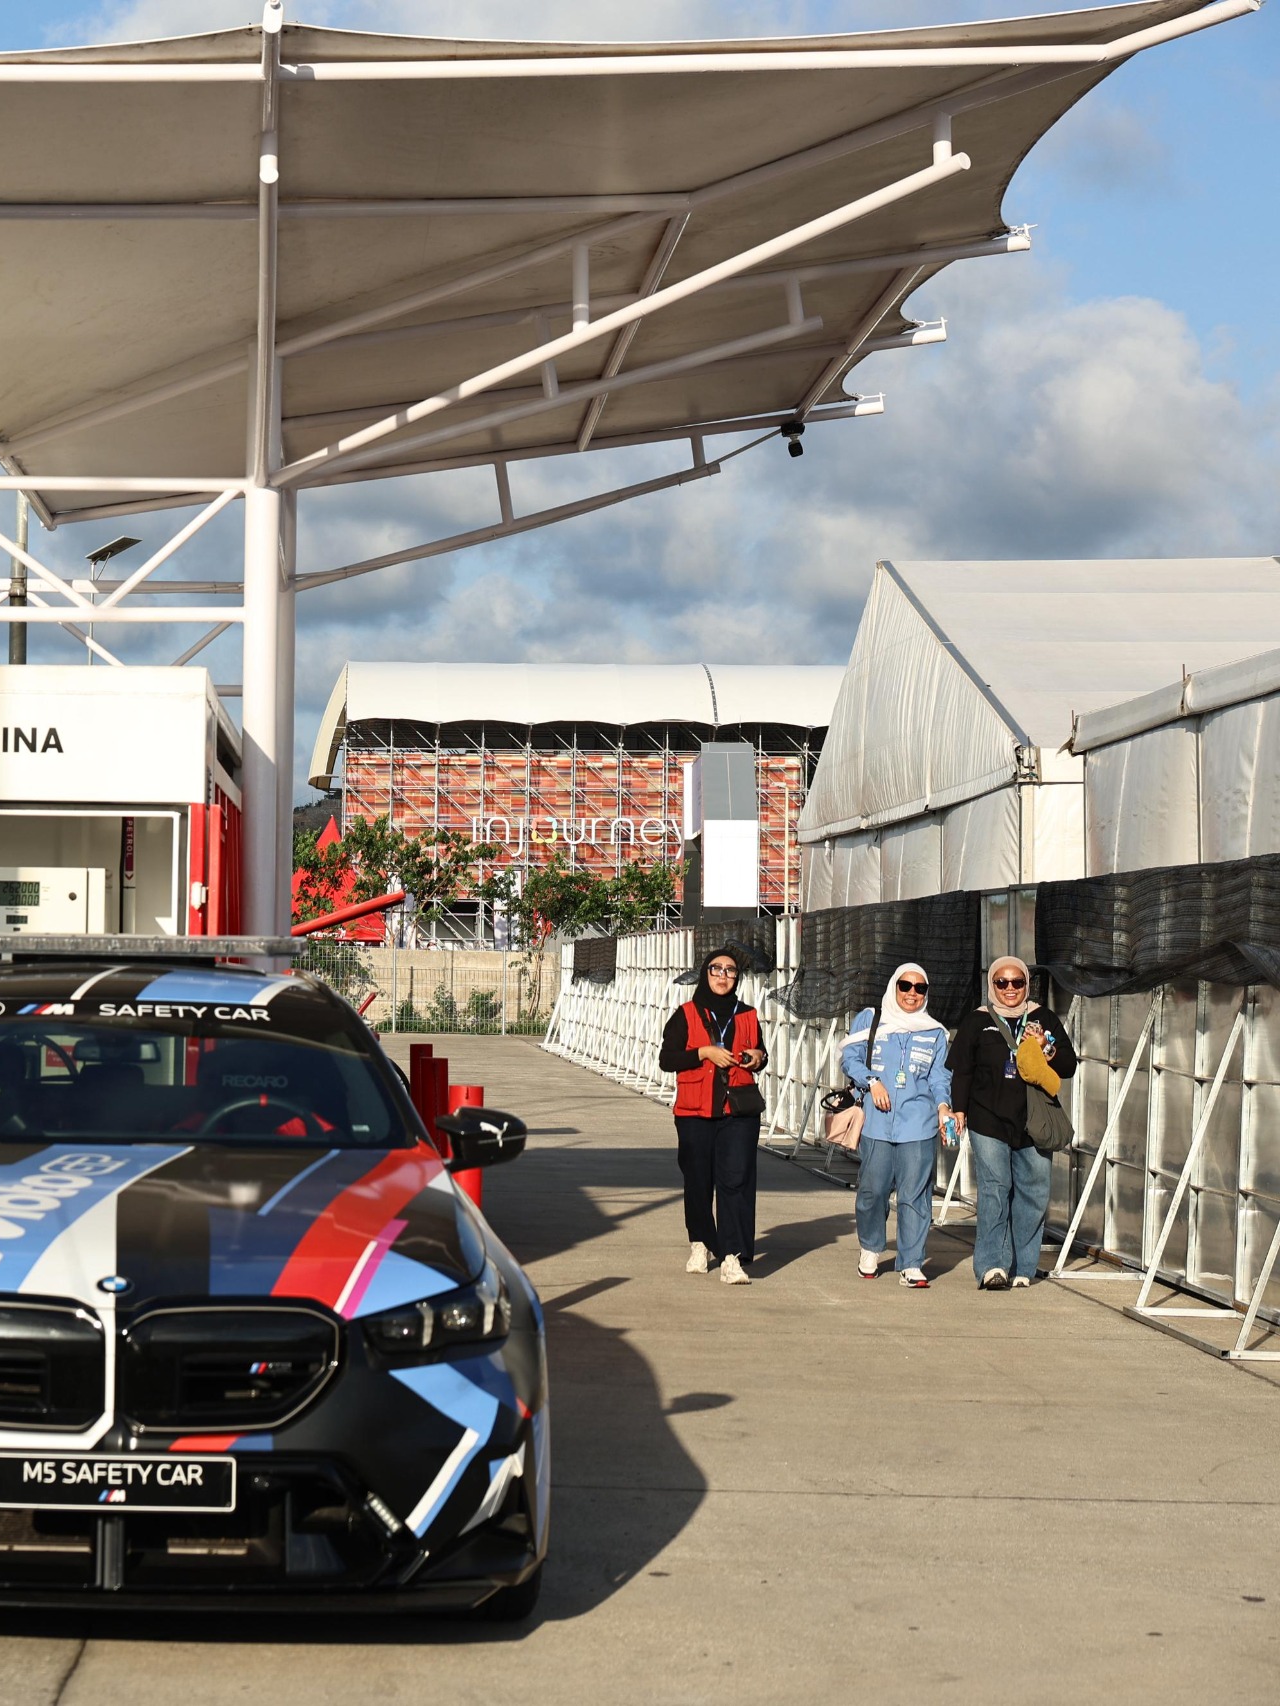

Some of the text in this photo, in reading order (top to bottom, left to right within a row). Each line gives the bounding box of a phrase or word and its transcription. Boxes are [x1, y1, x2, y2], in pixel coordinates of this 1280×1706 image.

[126, 820, 134, 858] PETROL
[99, 1003, 207, 1018] SAFETY
[214, 1006, 271, 1022] CAR
[222, 1075, 289, 1089] RECARO
[23, 1460, 203, 1486] M5 SAFETY CAR
